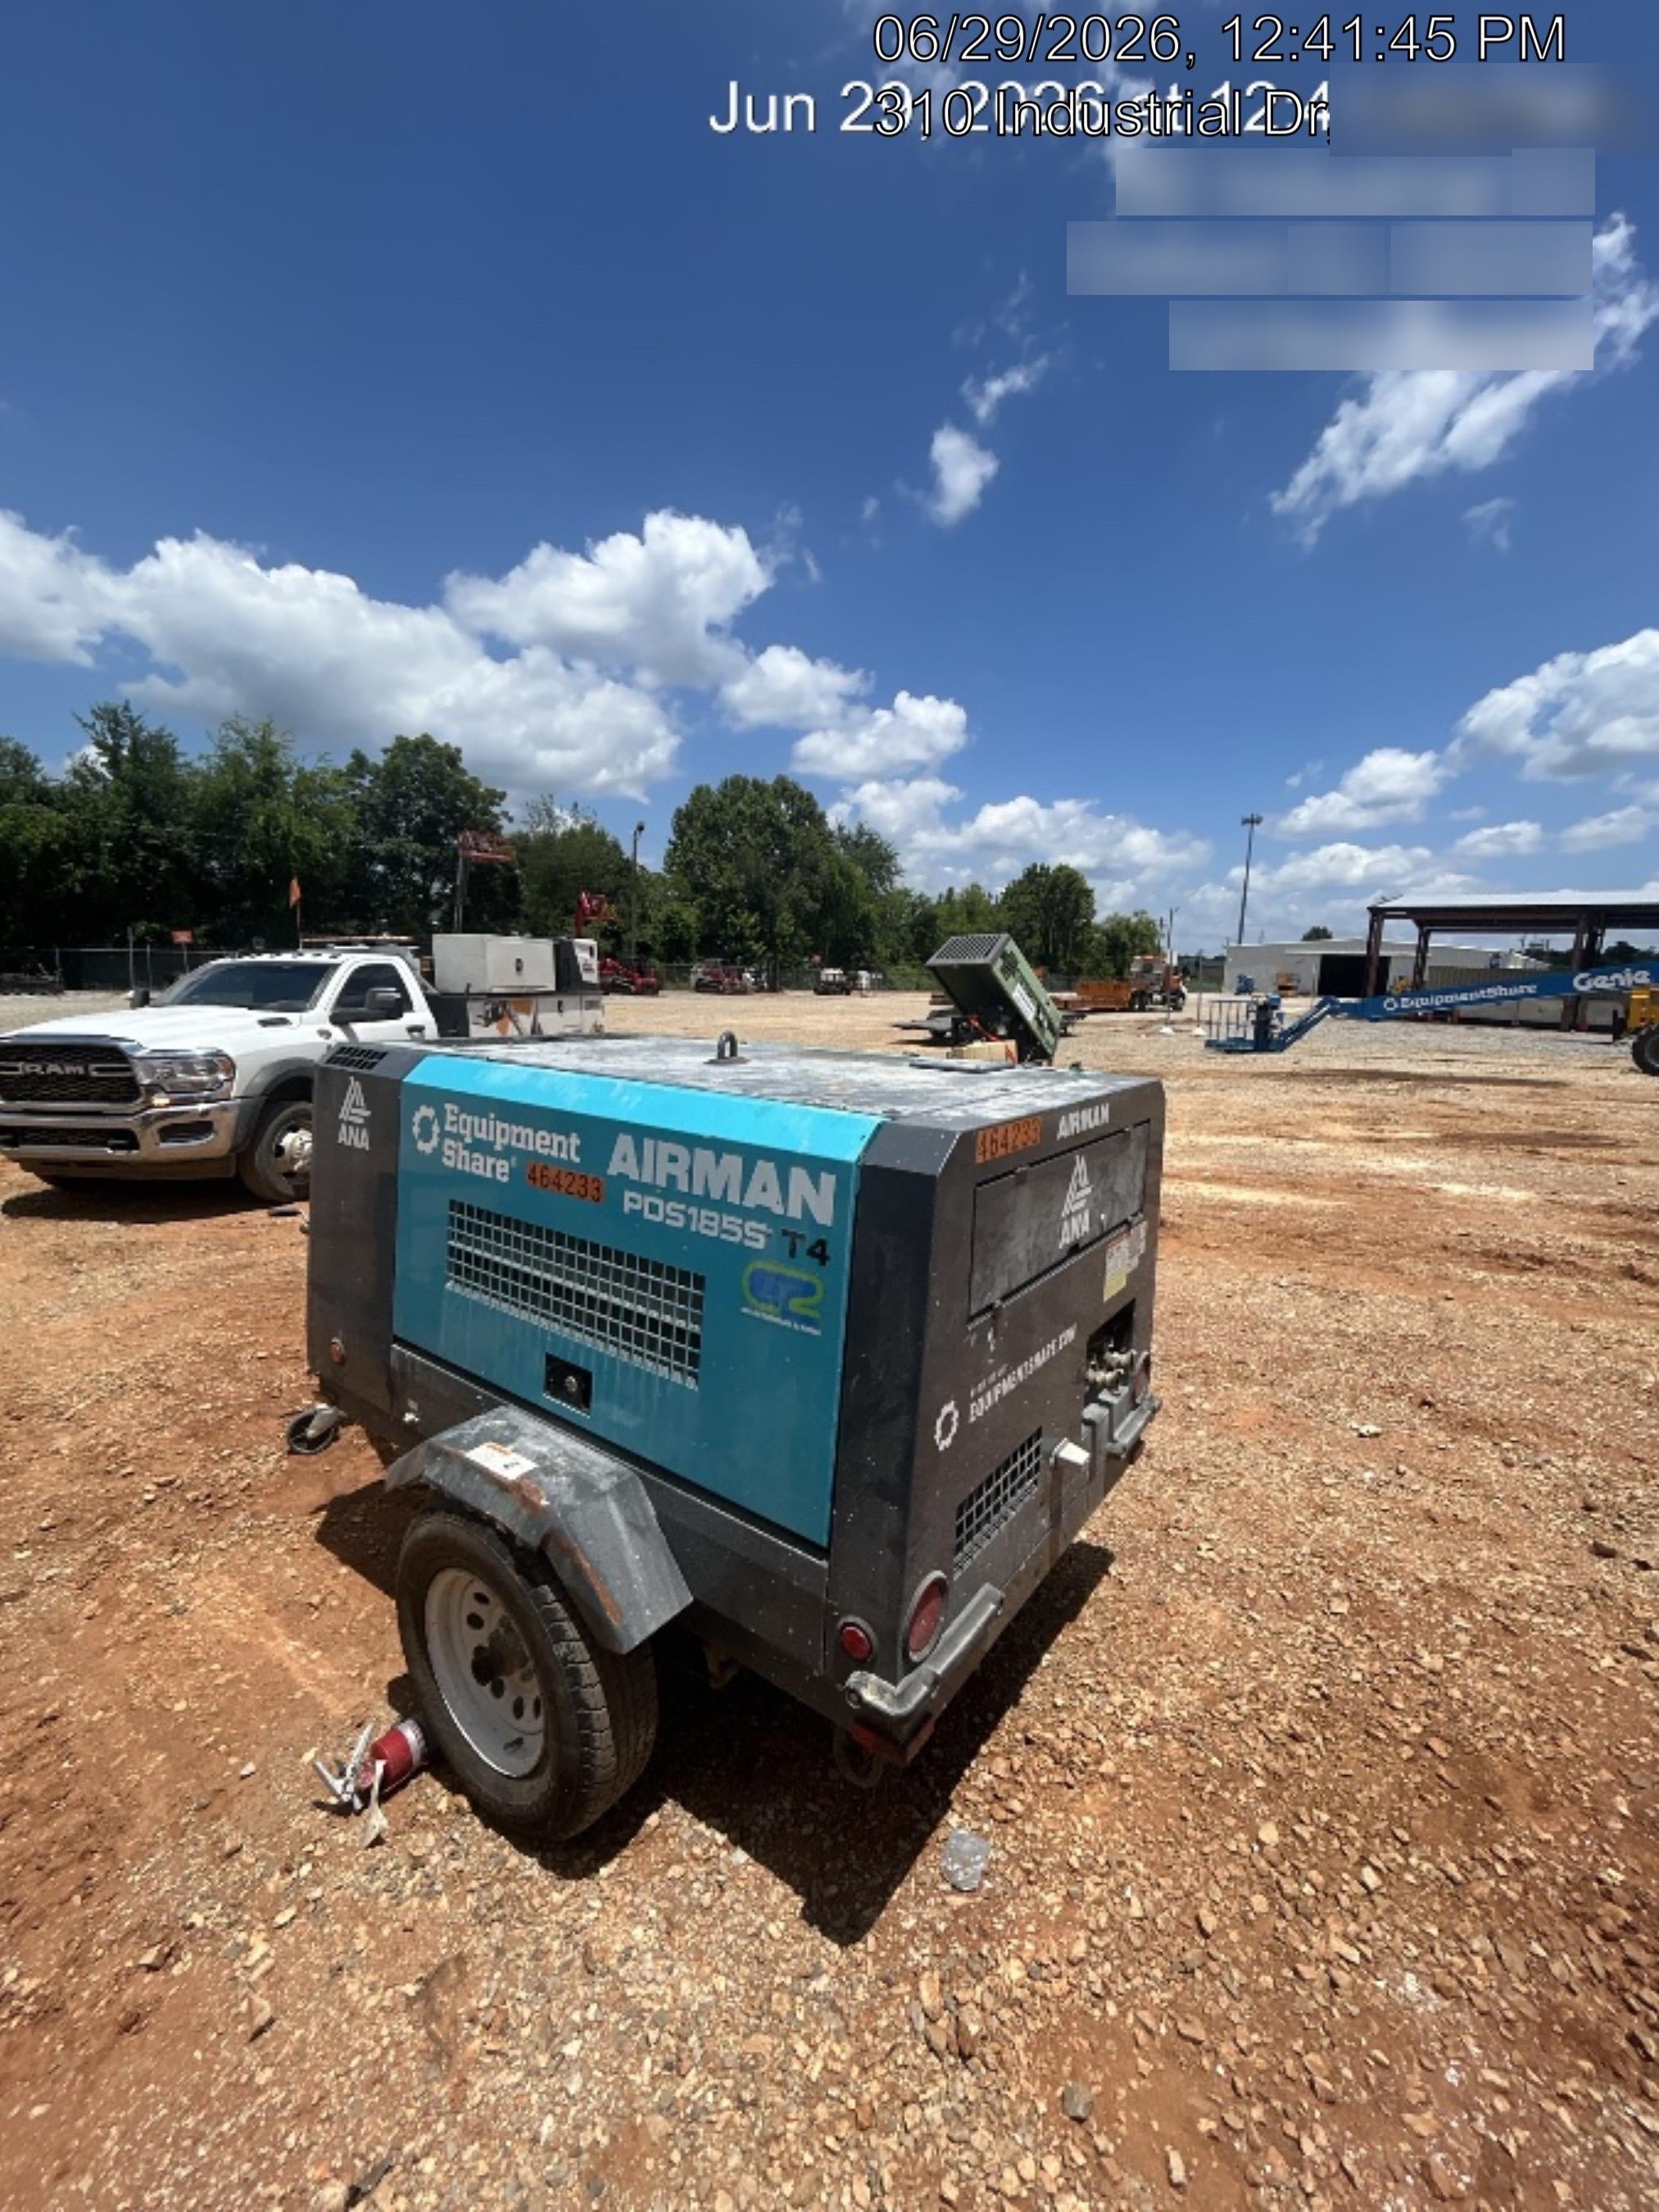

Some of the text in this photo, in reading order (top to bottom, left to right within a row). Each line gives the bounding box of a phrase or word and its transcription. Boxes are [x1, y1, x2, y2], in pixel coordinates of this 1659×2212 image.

[1400, 983, 1538, 1009] EquipmentShare
[1572, 968, 1652, 992] Genie
[25, 1063, 85, 1077] RAM
[337, 1122, 370, 1152] ANA
[444, 1102, 581, 1164] Equipment
[1056, 1103, 1110, 1140] AIRMAN
[442, 1136, 510, 1183] Share
[526, 1161, 603, 1203] 464233
[606, 1132, 836, 1228] AIRMAN
[1058, 1208, 1090, 1249] ANA
